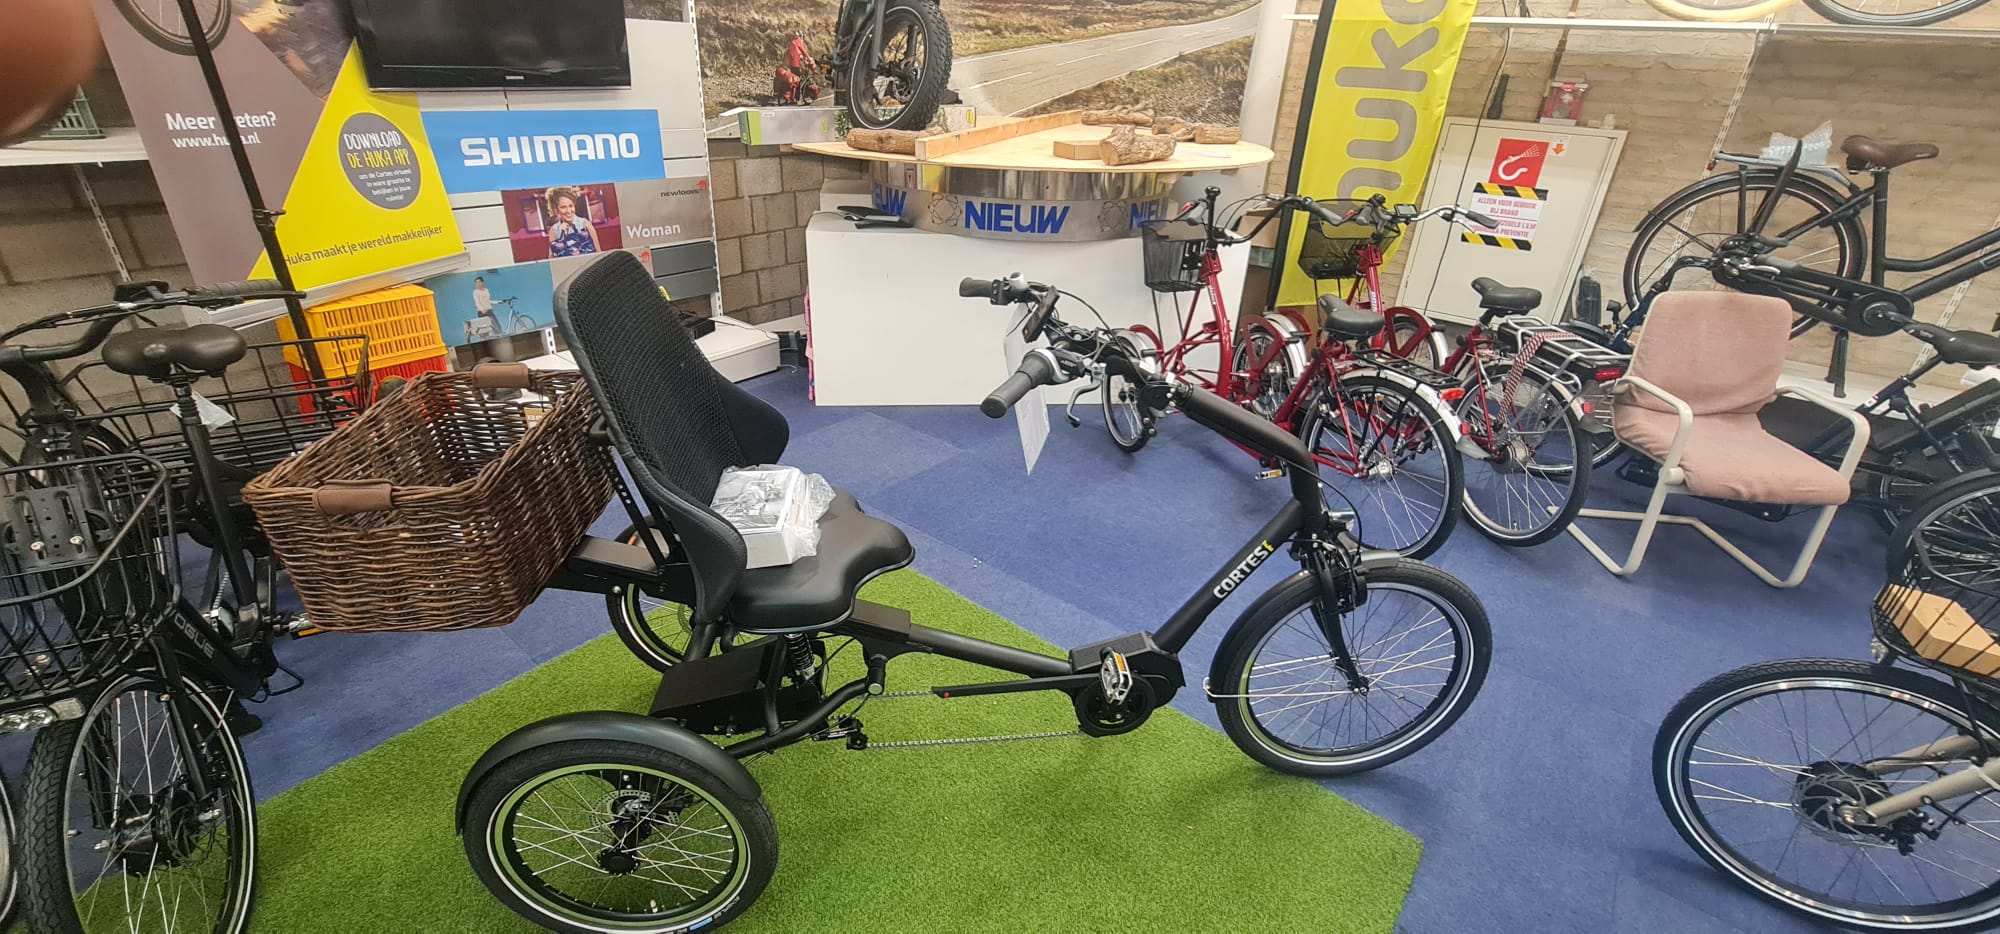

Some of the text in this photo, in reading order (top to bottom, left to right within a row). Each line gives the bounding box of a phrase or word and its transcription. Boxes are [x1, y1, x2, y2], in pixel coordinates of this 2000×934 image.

[165, 110, 277, 131] Meer eten?
[343, 131, 402, 150] DOWNLOAD
[460, 132, 641, 167] SHIMANO
[346, 148, 411, 168] DE HUKA APP
[626, 223, 681, 239] Woman
[965, 200, 1071, 234] NIEUW
[312, 245, 348, 261] maakt
[348, 241, 357, 255] je
[358, 234, 392, 251] wereld
[392, 226, 443, 243] makkelijker
[1213, 545, 1269, 599] CORTES
[174, 612, 215, 659] OGUE
